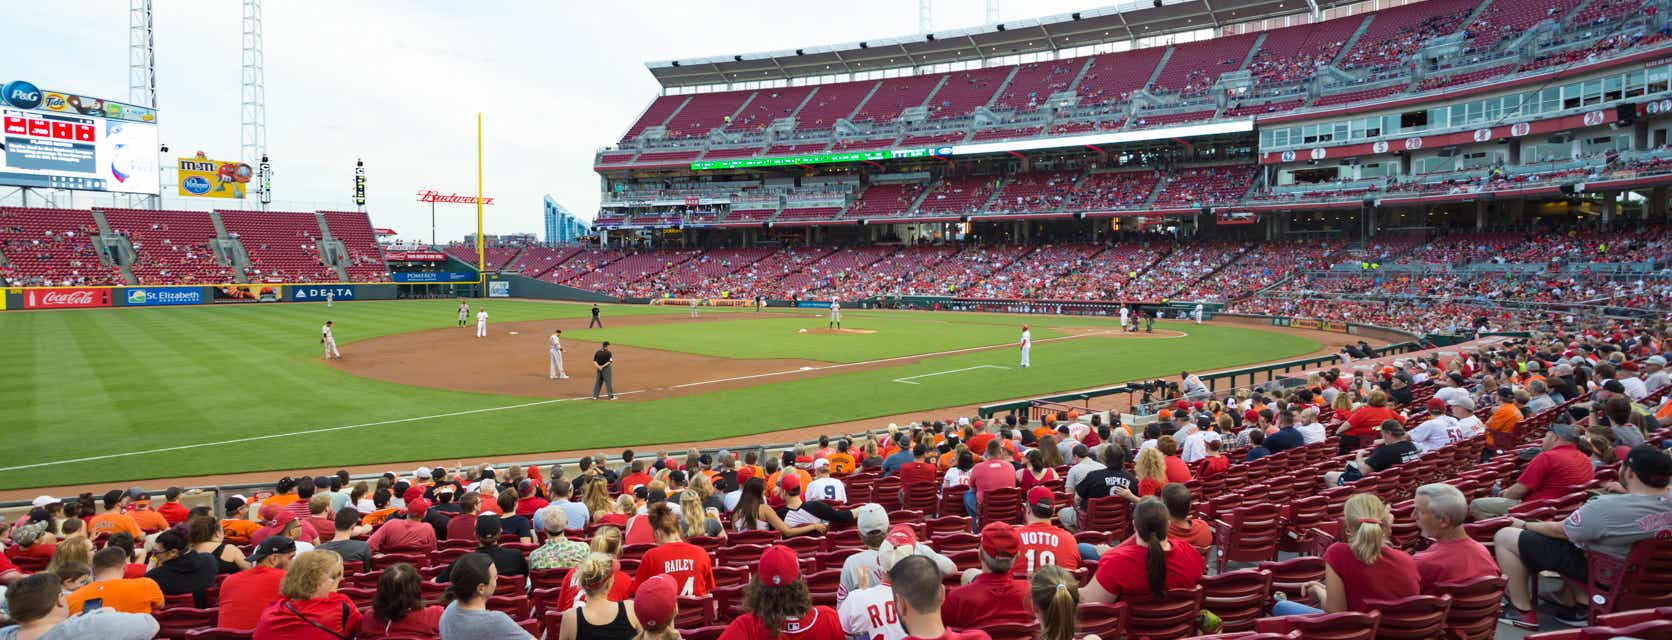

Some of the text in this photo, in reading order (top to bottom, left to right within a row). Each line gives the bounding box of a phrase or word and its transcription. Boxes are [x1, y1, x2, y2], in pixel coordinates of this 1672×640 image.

[12, 89, 39, 101] P&G
[46, 97, 65, 107] Tide
[42, 291, 94, 304] Coca-Cola
[158, 291, 200, 299] Elizabeth
[1104, 476, 1131, 488] RIPKEN
[824, 484, 836, 500] 9
[1020, 531, 1059, 547] VOTTO
[664, 559, 694, 574] BAILEY
